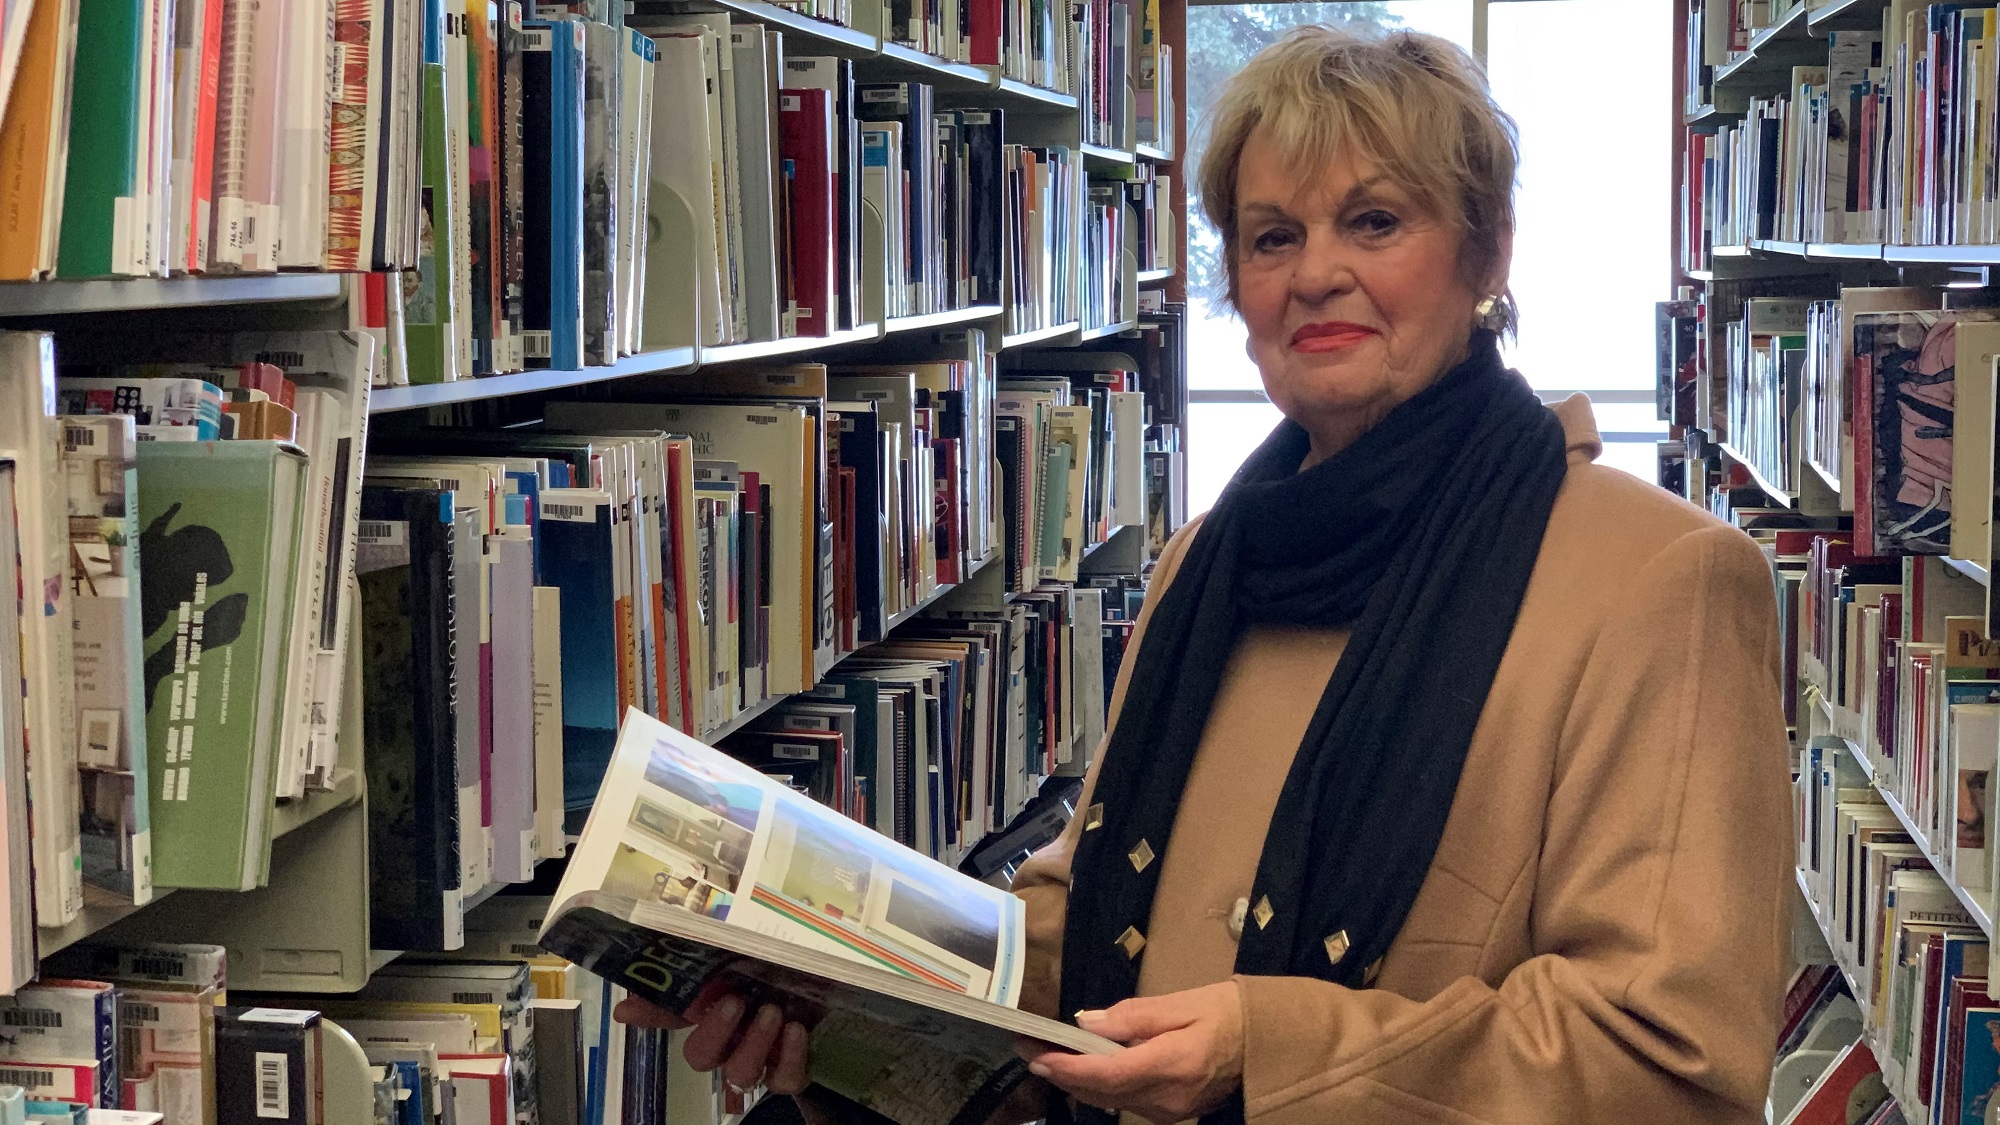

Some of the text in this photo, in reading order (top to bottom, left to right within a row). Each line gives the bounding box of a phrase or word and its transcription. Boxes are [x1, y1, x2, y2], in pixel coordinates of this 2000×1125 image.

[207, 53, 218, 99] EASY
[325, 54, 333, 84] BY
[323, 91, 332, 155] HAND
[626, 131, 634, 189] Gagnon
[692, 444, 715, 454] HIC
[346, 532, 358, 596] HOME
[302, 560, 322, 724] STYLE SECRETS
[1910, 911, 1961, 923] PETITES
